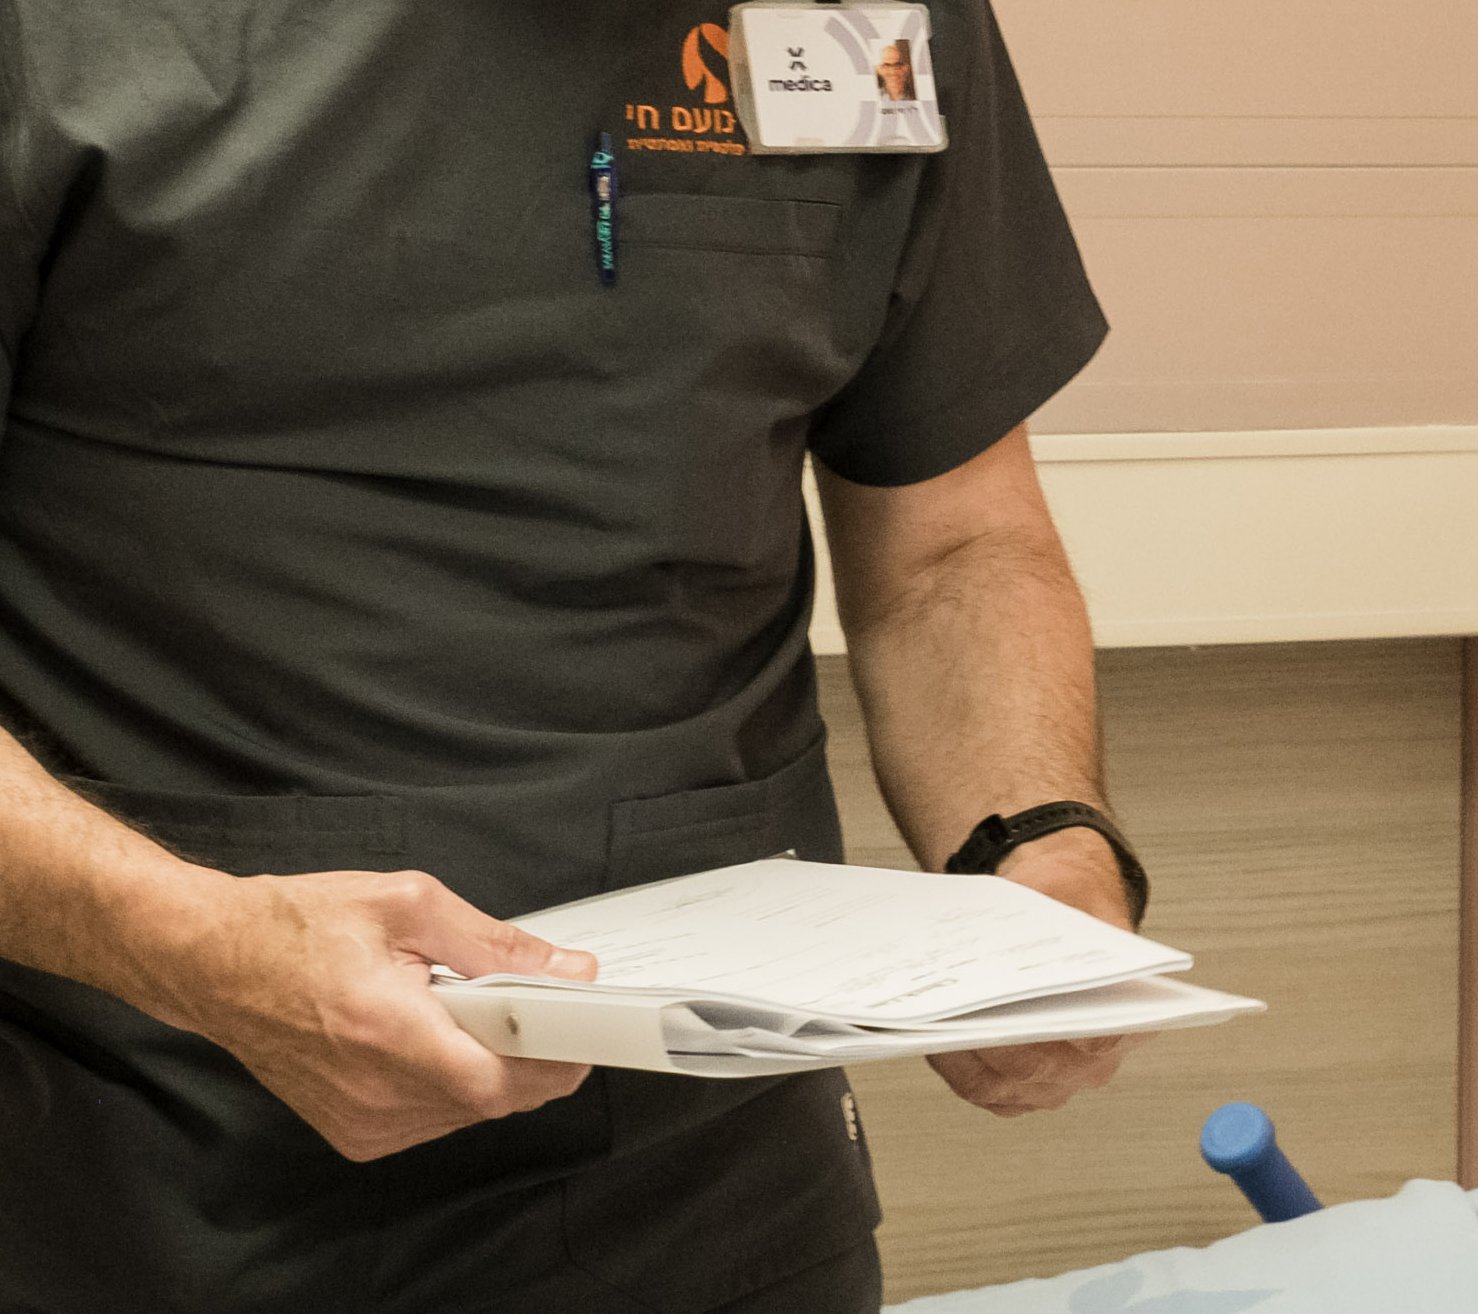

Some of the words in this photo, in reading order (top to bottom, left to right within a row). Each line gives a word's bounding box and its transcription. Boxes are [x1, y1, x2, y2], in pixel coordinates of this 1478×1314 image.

[768, 75, 833, 92] medica
[625, 104, 660, 130] חי
[671, 106, 736, 134] נועם
